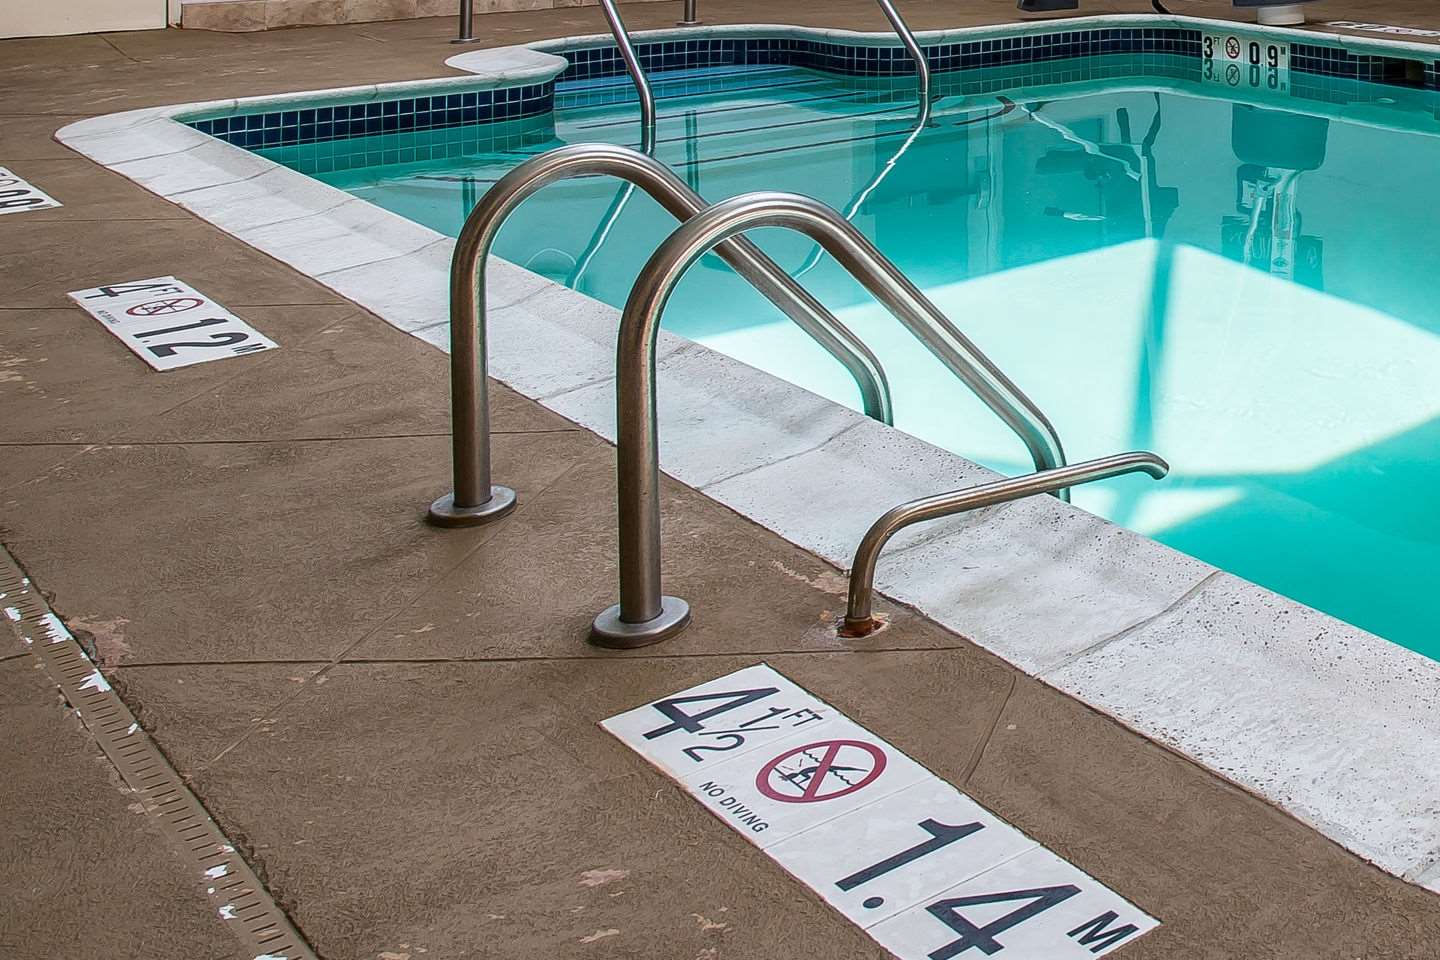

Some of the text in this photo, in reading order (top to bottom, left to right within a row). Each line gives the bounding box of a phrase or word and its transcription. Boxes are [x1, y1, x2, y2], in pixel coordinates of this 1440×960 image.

[1203, 36, 1214, 59] 3
[643, 687, 780, 740] 4
[785, 707, 824, 730] FT
[701, 780, 769, 834] NO DIVING
[1066, 910, 1139, 954] M
